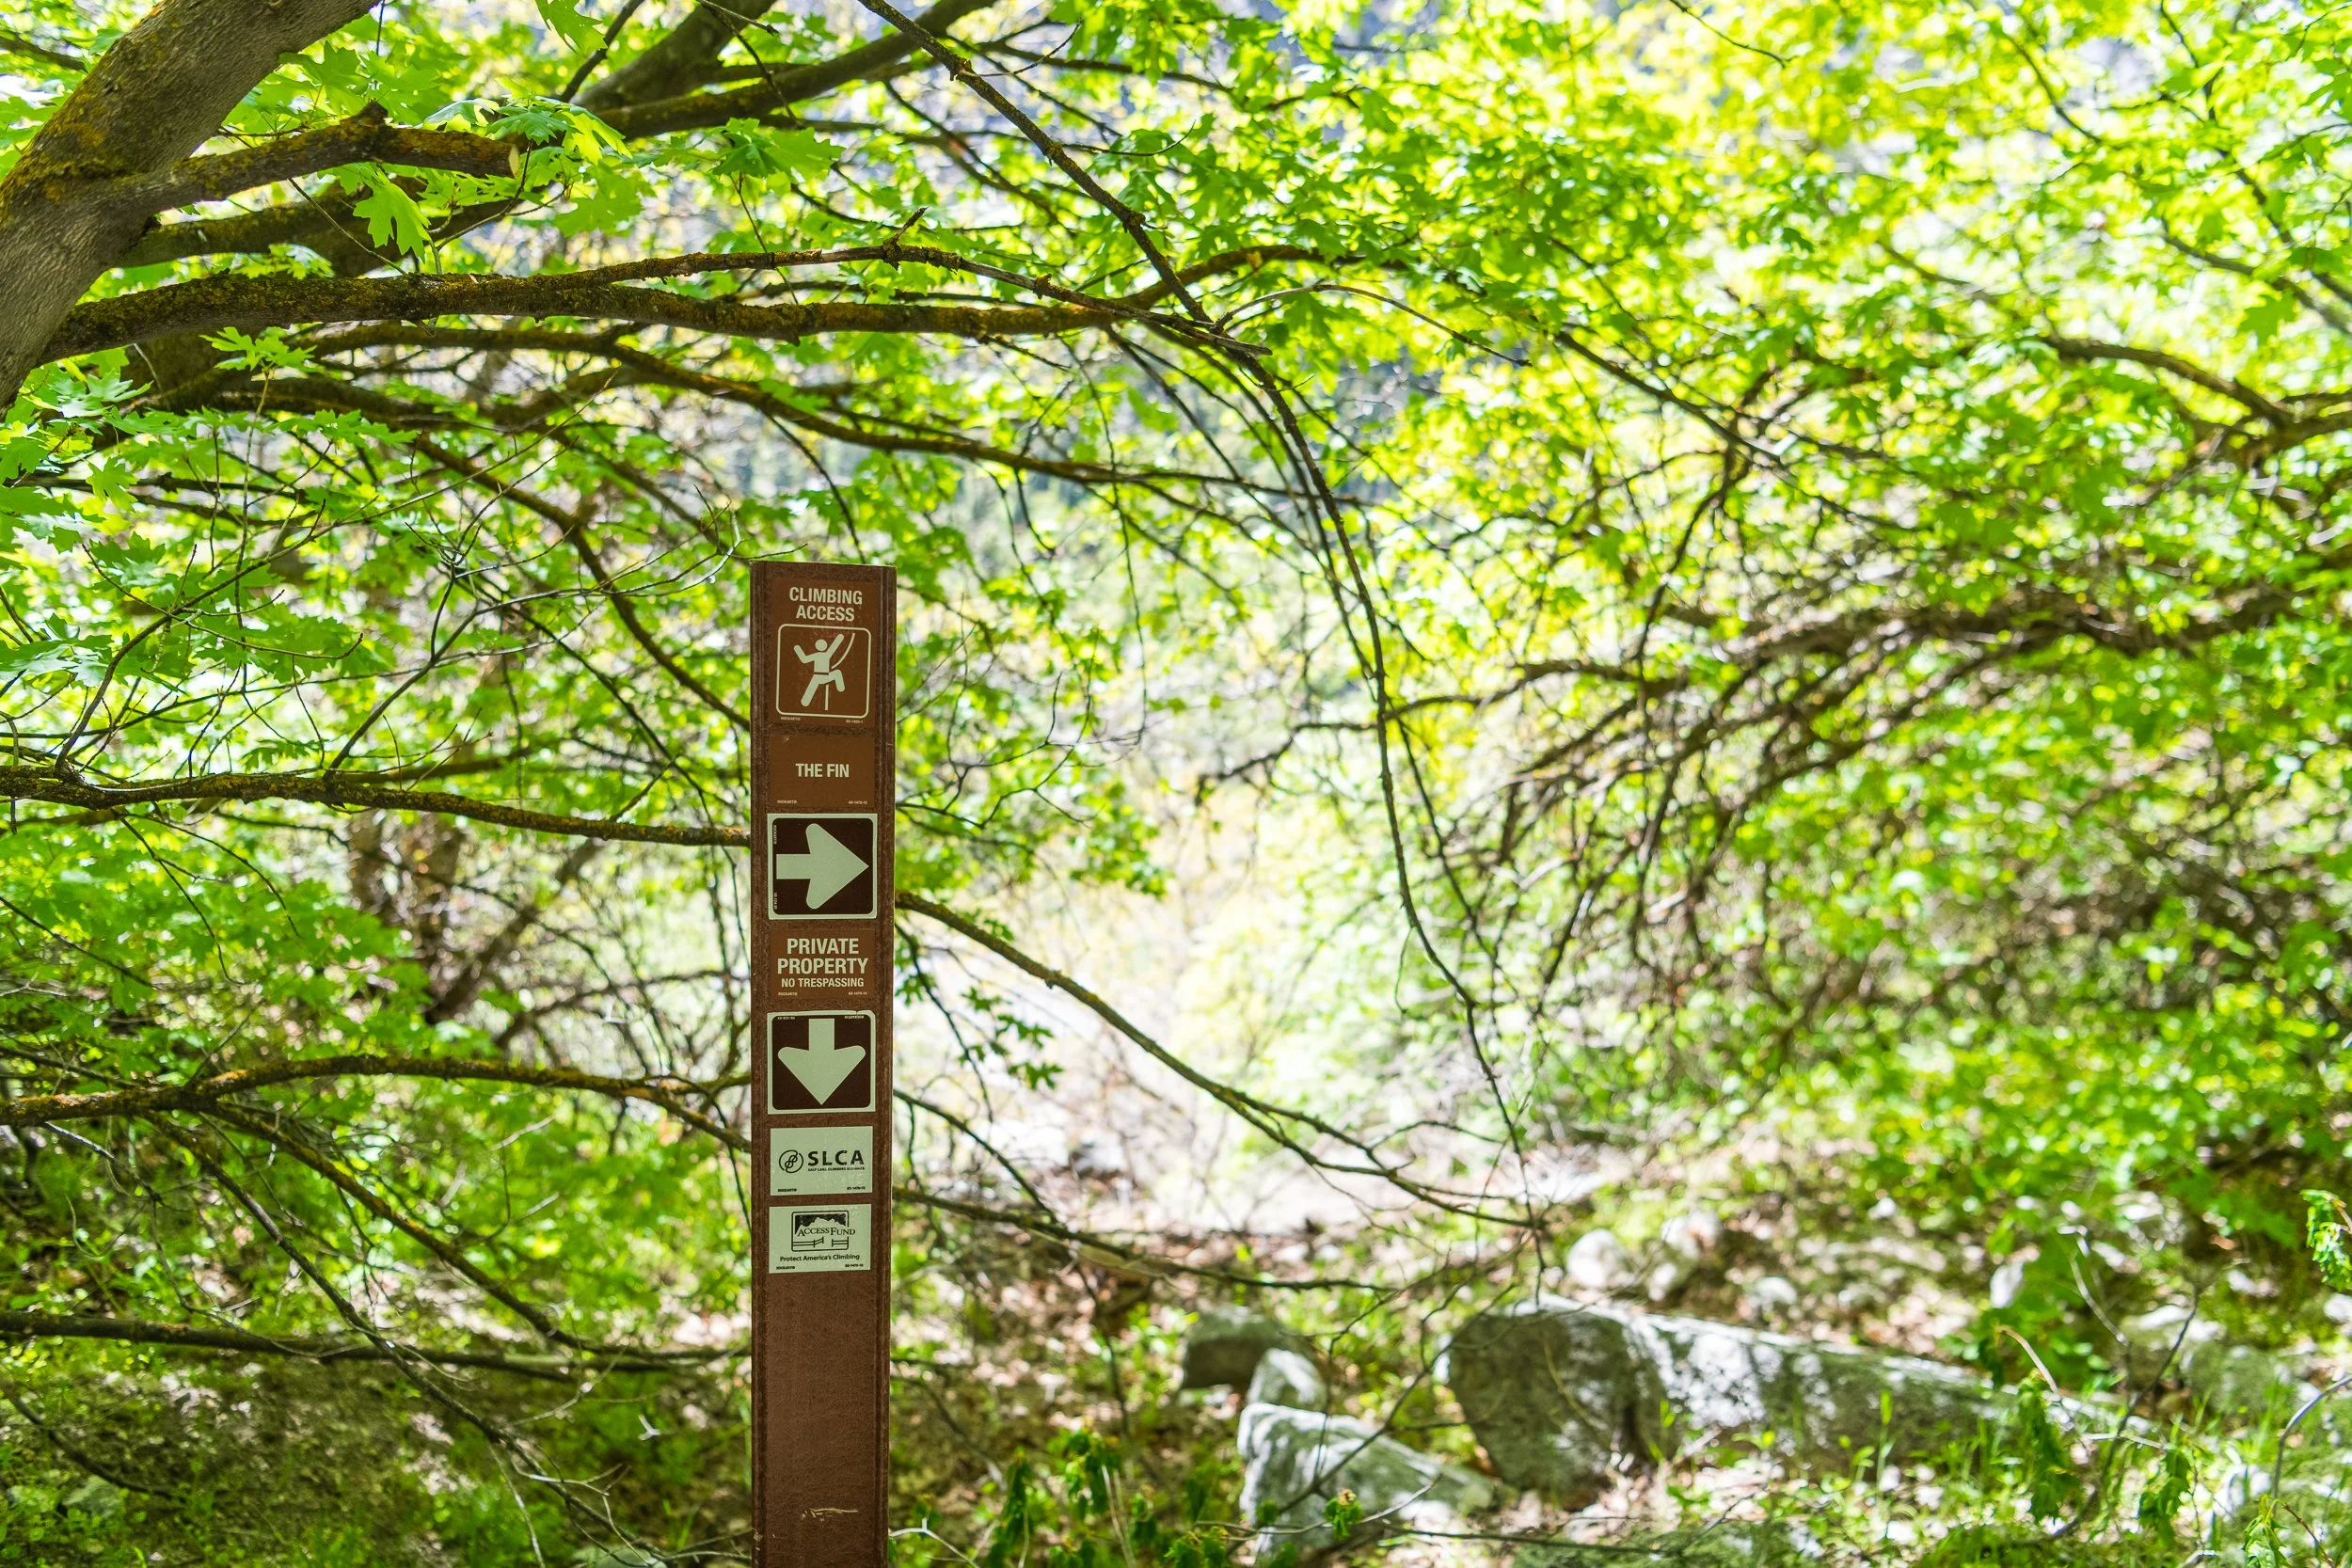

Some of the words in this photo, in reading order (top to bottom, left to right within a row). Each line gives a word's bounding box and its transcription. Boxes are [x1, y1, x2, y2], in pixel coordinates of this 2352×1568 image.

[788, 586, 863, 605] CLIMBING
[795, 605, 855, 622] ACCESS
[795, 763, 823, 778] THE
[826, 763, 850, 778] FIN
[787, 938, 859, 955] PRIVATE
[777, 958, 868, 974] PROPERTY
[781, 977, 796, 988] NO
[798, 977, 865, 988] TRESPASSING
[807, 1149, 865, 1166] SLCA
[797, 1227, 830, 1237] ACCESS
[830, 1226, 856, 1236] FUND
[833, 1253, 860, 1261] Climbing
